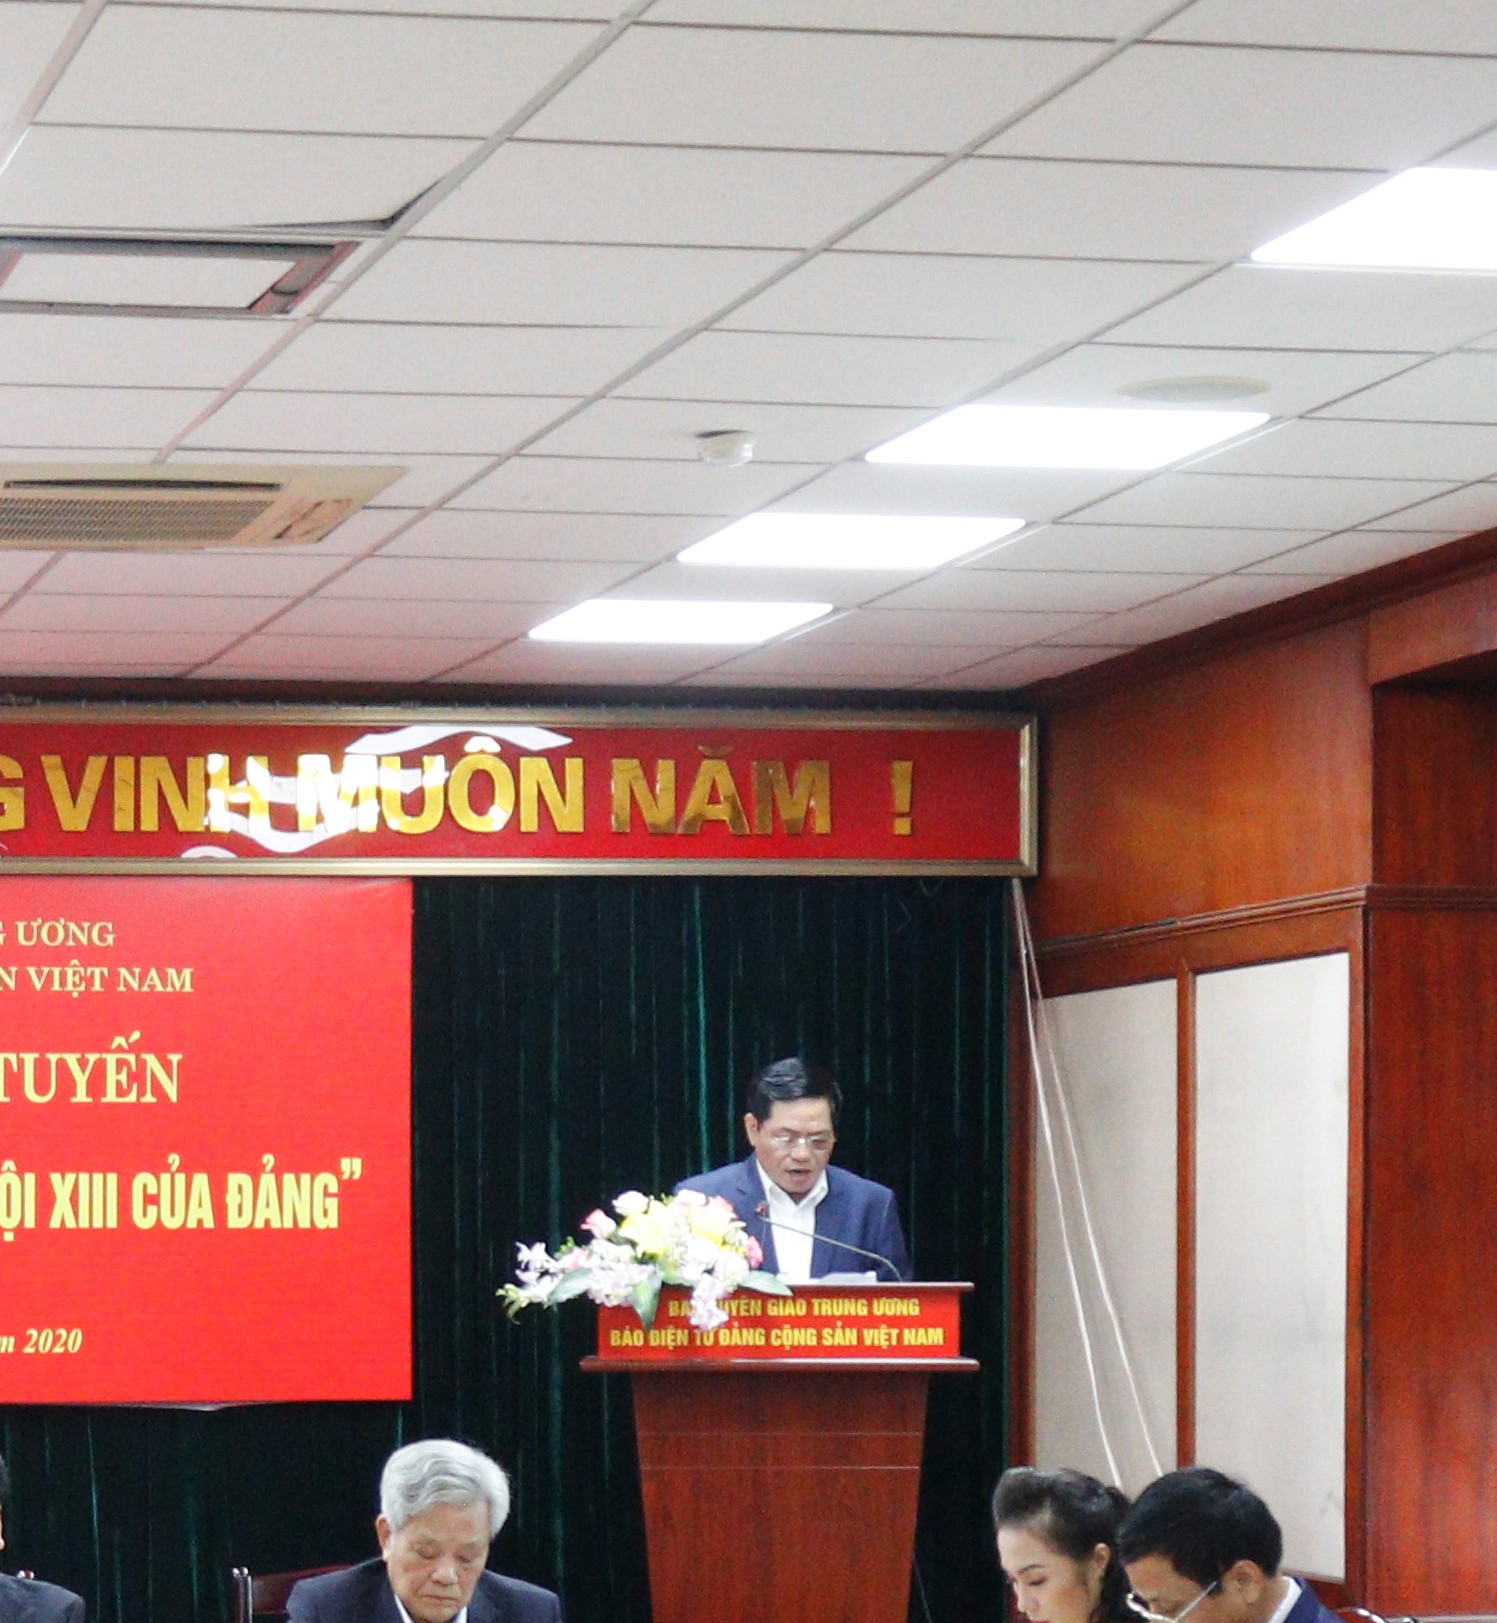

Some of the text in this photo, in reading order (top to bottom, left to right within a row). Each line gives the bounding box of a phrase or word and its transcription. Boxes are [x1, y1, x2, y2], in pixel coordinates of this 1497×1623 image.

[41, 754, 270, 832] VINH
[296, 736, 585, 834] MUÔN
[611, 745, 831, 835] NĂM
[890, 760, 914, 836] !
[16, 918, 115, 946] ƯƠNG
[27, 960, 108, 997] VIỆT
[118, 968, 193, 992] NAM
[50, 1173, 117, 1228] XIII
[132, 1154, 214, 1229] CỦA
[767, 1296, 806, 1316] GIÁO
[812, 1298, 868, 1316] TRUNG
[872, 1297, 920, 1316] ƯƠNG
[24, 1329, 82, 1353] 2020
[718, 1321, 766, 1346] ĐẢNG
[771, 1324, 817, 1350] CỘNG
[822, 1321, 857, 1346] SẢN
[863, 1324, 899, 1350] VIỆT
[904, 1328, 944, 1346] NAM
